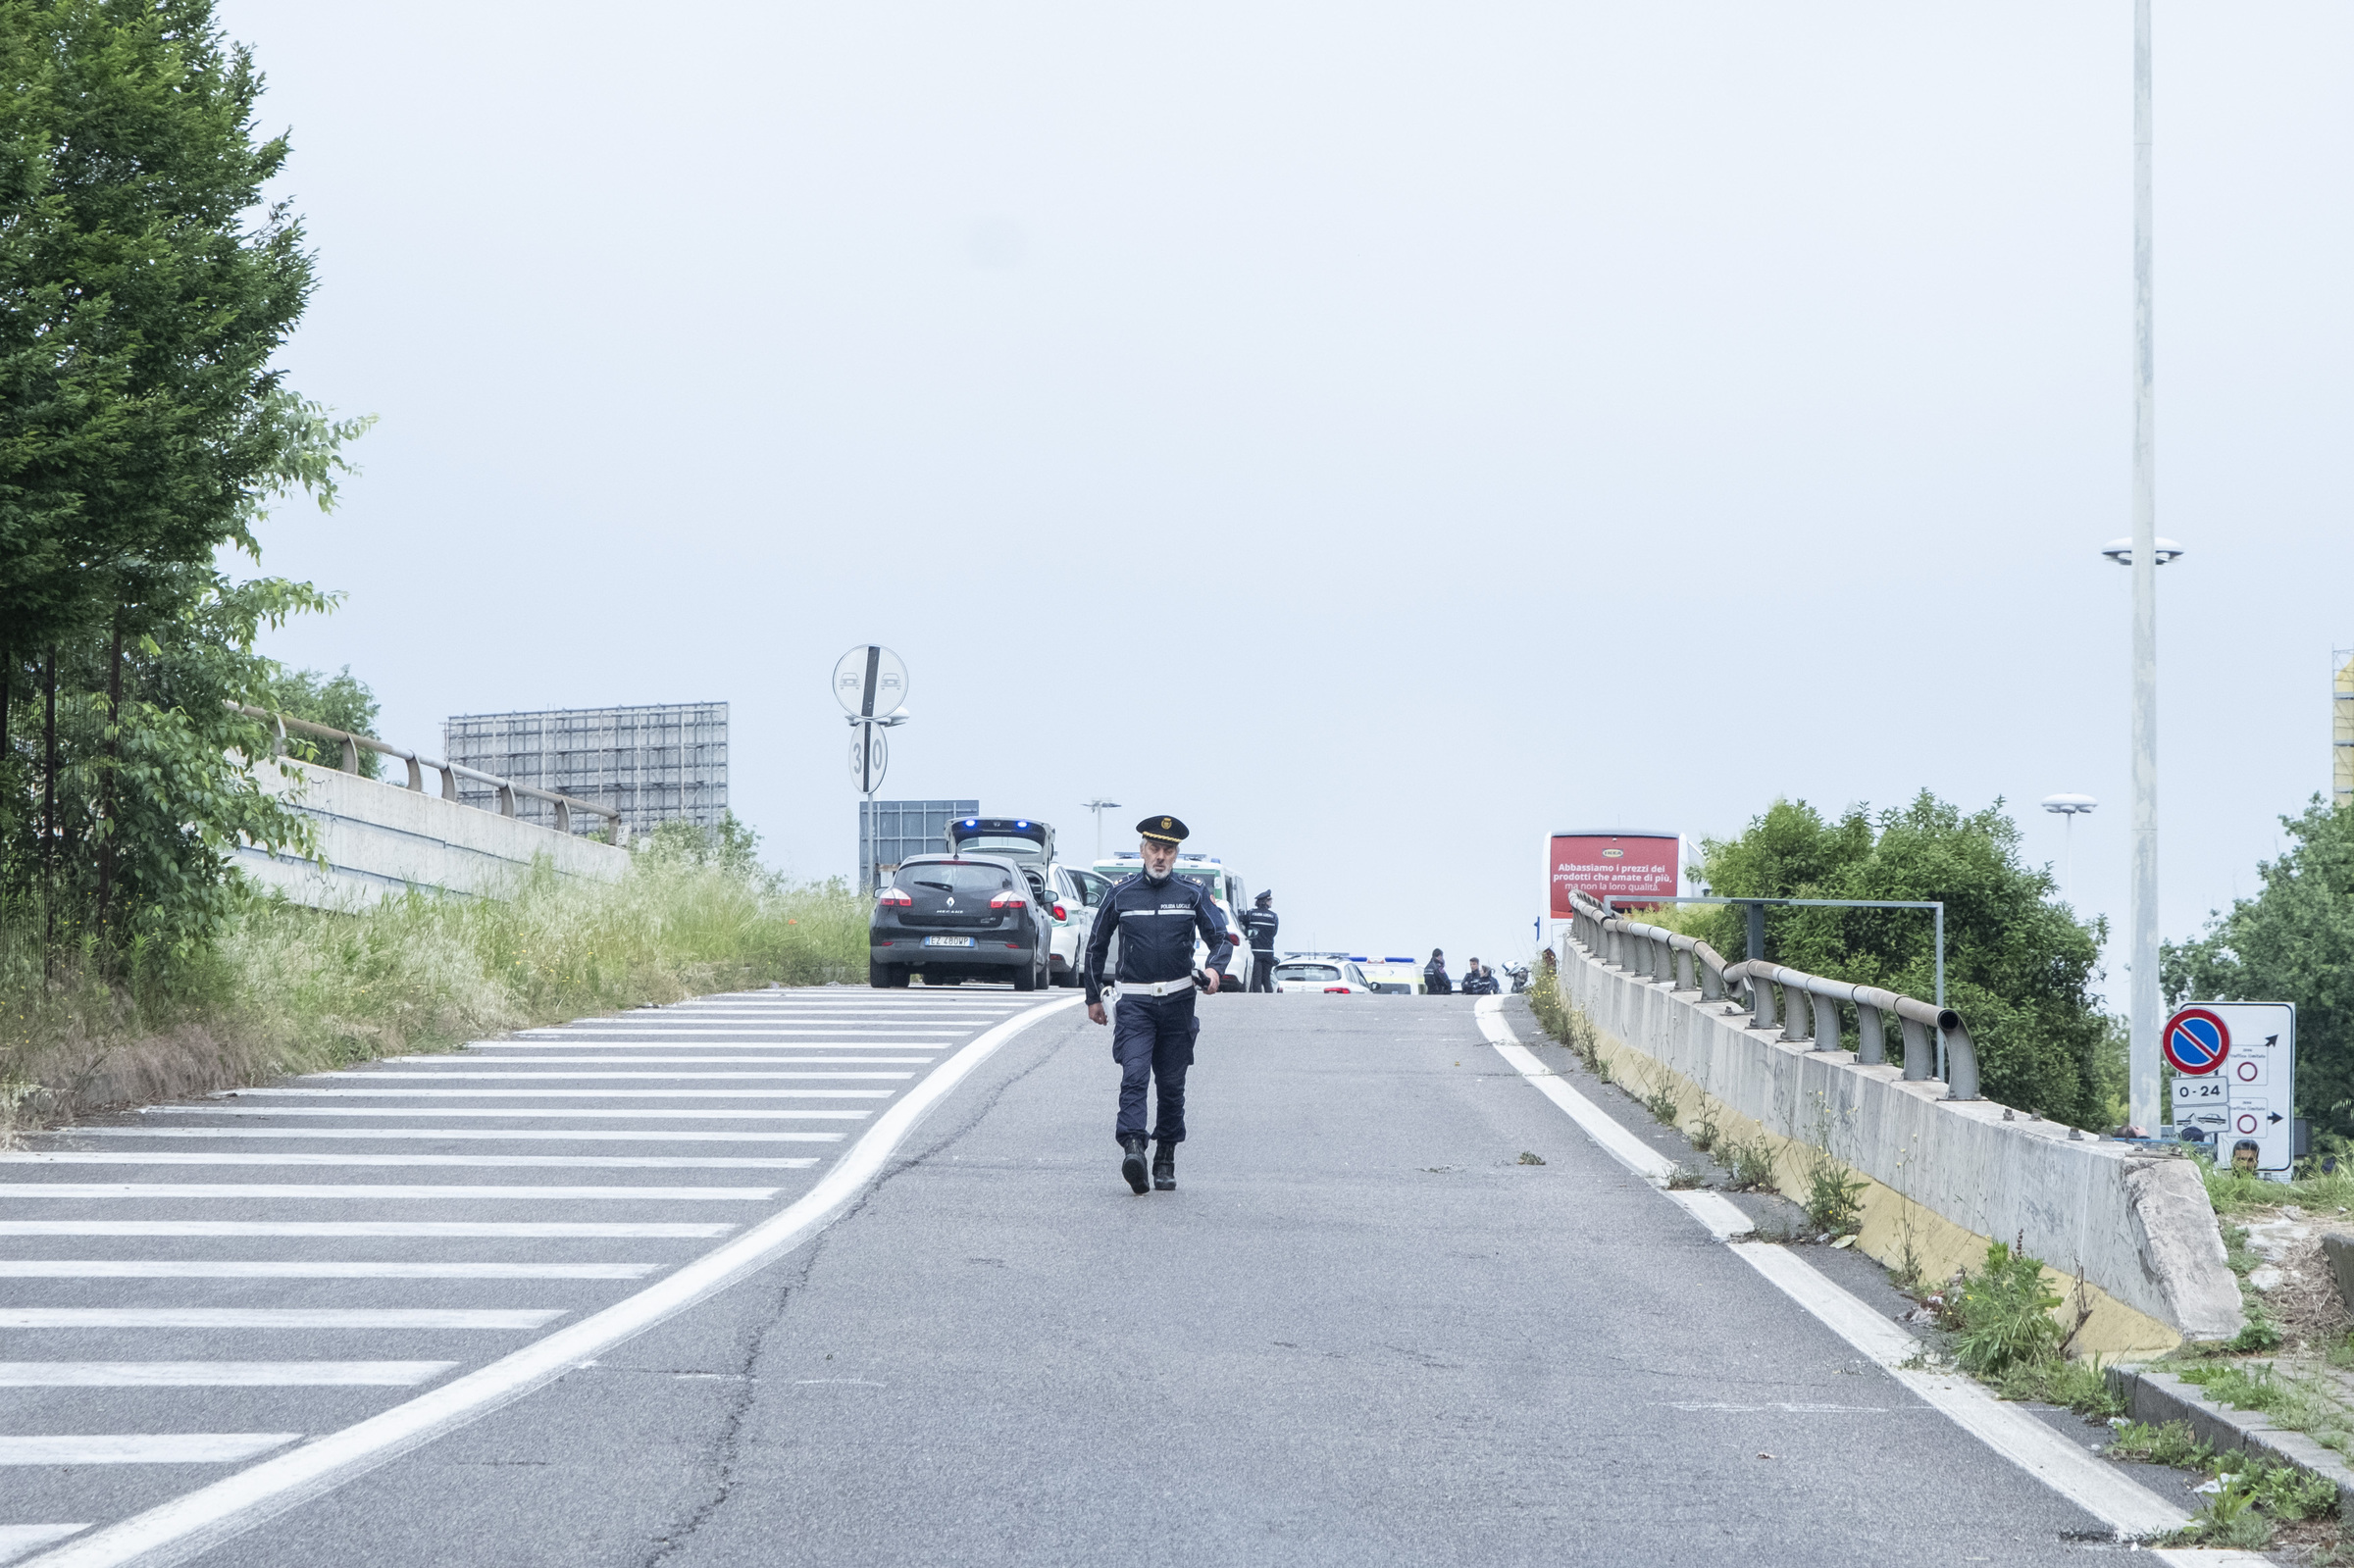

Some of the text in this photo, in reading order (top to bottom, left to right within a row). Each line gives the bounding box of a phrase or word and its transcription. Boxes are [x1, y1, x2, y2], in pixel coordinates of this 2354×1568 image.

[1558, 863, 1614, 872] Abbassiamo
[1621, 864, 1649, 875] prezzi
[1553, 872, 1591, 883] prodotti
[1655, 874, 1672, 884] più,
[1609, 883, 1626, 891] loro
[1627, 883, 1661, 893] qualità.
[931, 936, 941, 945] EZ
